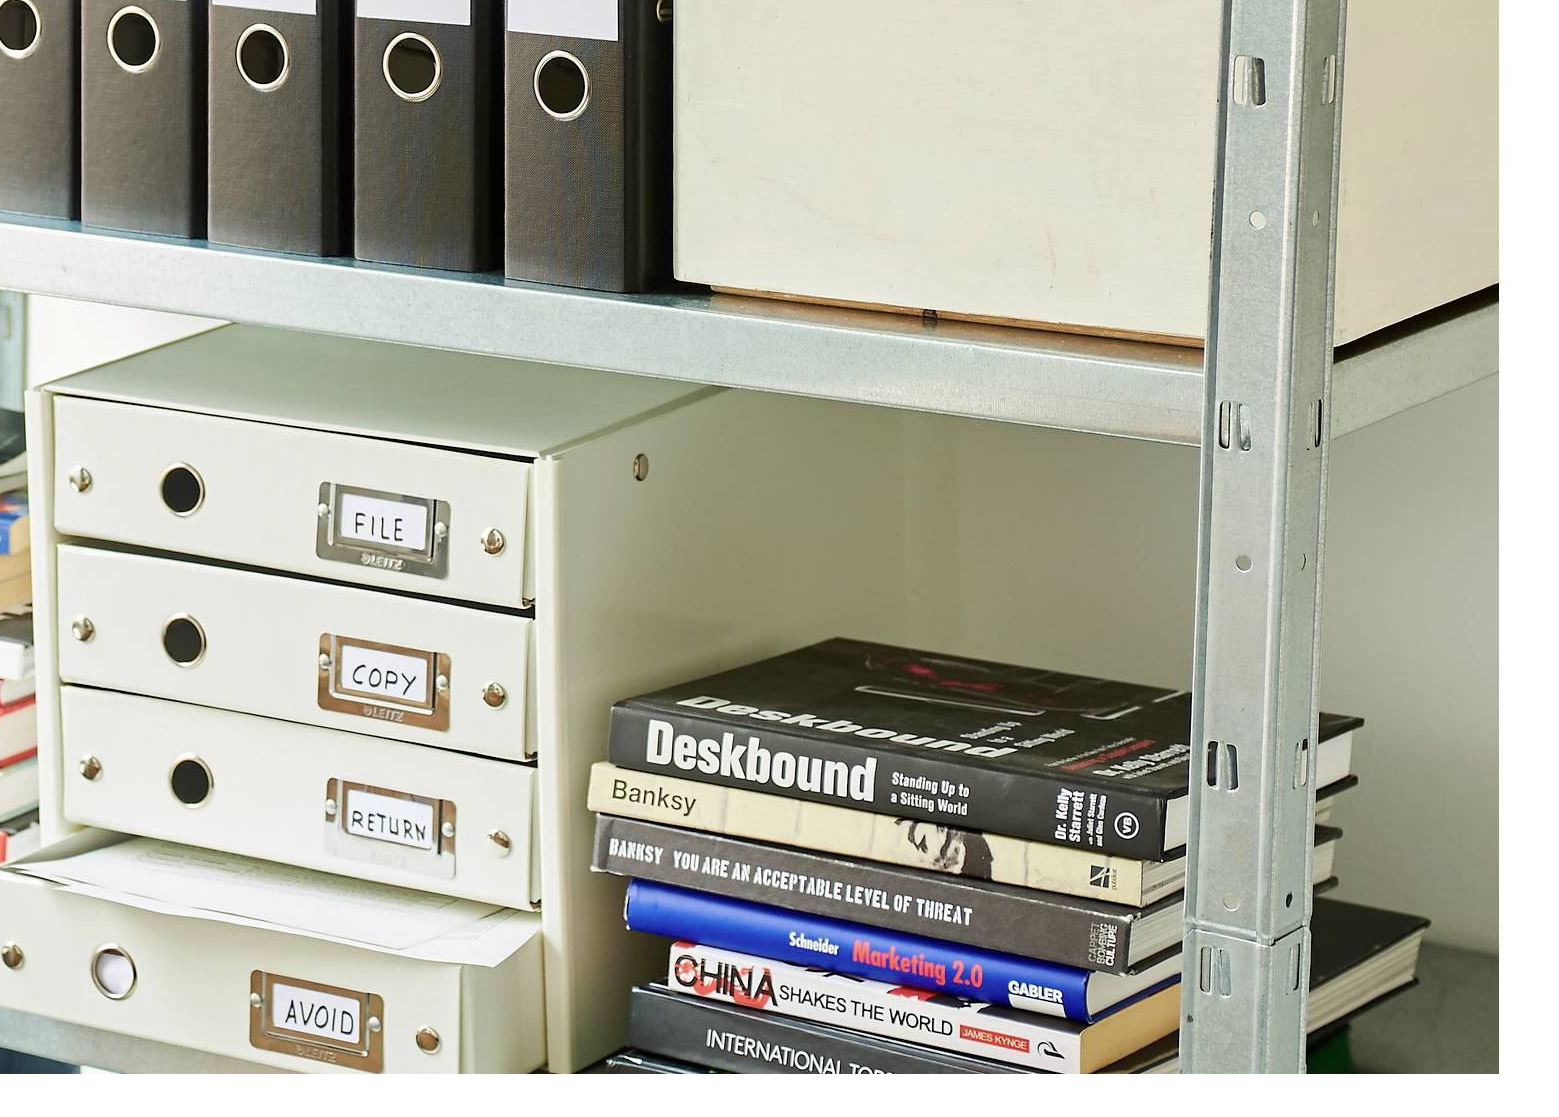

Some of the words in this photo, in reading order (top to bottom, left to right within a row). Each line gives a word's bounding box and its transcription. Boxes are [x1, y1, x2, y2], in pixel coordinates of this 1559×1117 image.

[354, 512, 404, 542] FILE
[352, 664, 417, 696] COPY
[676, 695, 1019, 758] Deskbound
[645, 718, 878, 803] Deskbound
[611, 778, 697, 817] Banksy
[891, 771, 939, 795] Standing
[940, 779, 956, 798] Up
[958, 782, 970, 798] to
[890, 792, 898, 804] a
[899, 791, 935, 813] Sitting
[937, 797, 968, 816] World
[1054, 787, 1073, 820] Kelly
[1068, 790, 1085, 843] Starrett
[351, 810, 426, 842] RETURN
[1054, 823, 1067, 841] Dr.
[1122, 816, 1133, 834] VB
[608, 837, 664, 866] BANKSY
[672, 849, 701, 872] YOU
[701, 855, 729, 879] ARE
[731, 861, 751, 883] AN
[752, 865, 843, 902] ACCEPTABLE
[845, 882, 890, 911] LEVEL
[893, 895, 914, 916] OF
[915, 897, 974, 927] THREAT
[788, 931, 840, 957] Schneider
[1105, 924, 1118, 967] CULTURE
[852, 938, 946, 985] Marketing
[951, 960, 984, 989] 2.0
[673, 953, 779, 1008] CHINA
[778, 983, 848, 1014] SHAKES
[850, 998, 885, 1023] THE
[887, 1008, 954, 1037] WORLD
[1007, 979, 1065, 1006] GABLER
[284, 999, 354, 1036] AVOID
[705, 1027, 842, 1075] INTERNATIONAL
[961, 1027, 994, 1044] JAMES
[994, 1034, 1029, 1052] KYNGE
